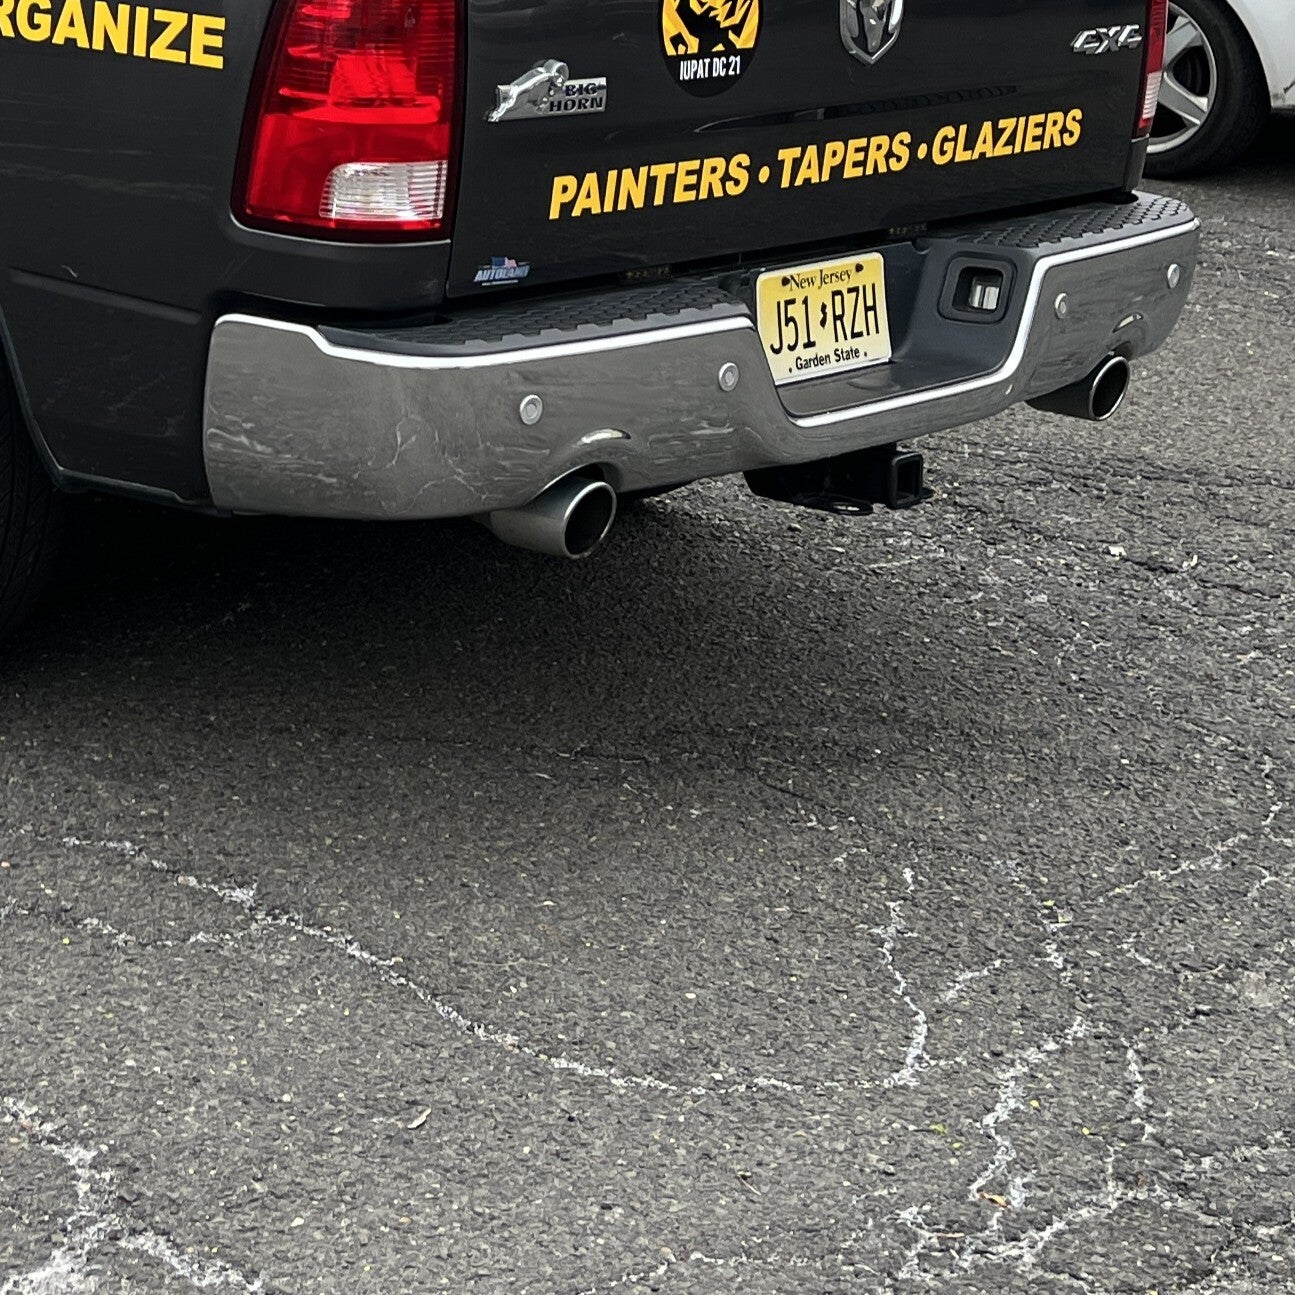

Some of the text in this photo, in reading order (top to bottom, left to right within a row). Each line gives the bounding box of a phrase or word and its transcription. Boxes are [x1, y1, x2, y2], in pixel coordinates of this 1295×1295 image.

[1069, 24, 1143, 55] 4X4
[679, 54, 741, 81] IUPAT DC 21
[565, 83, 598, 97] BIG
[548, 96, 603, 113] HORN
[548, 108, 1083, 221] PAINTERS TAPERS GLAZIERS
[788, 268, 852, 292] New Jersey
[769, 282, 880, 355] J51 RZH
[795, 346, 860, 371] Garden State
